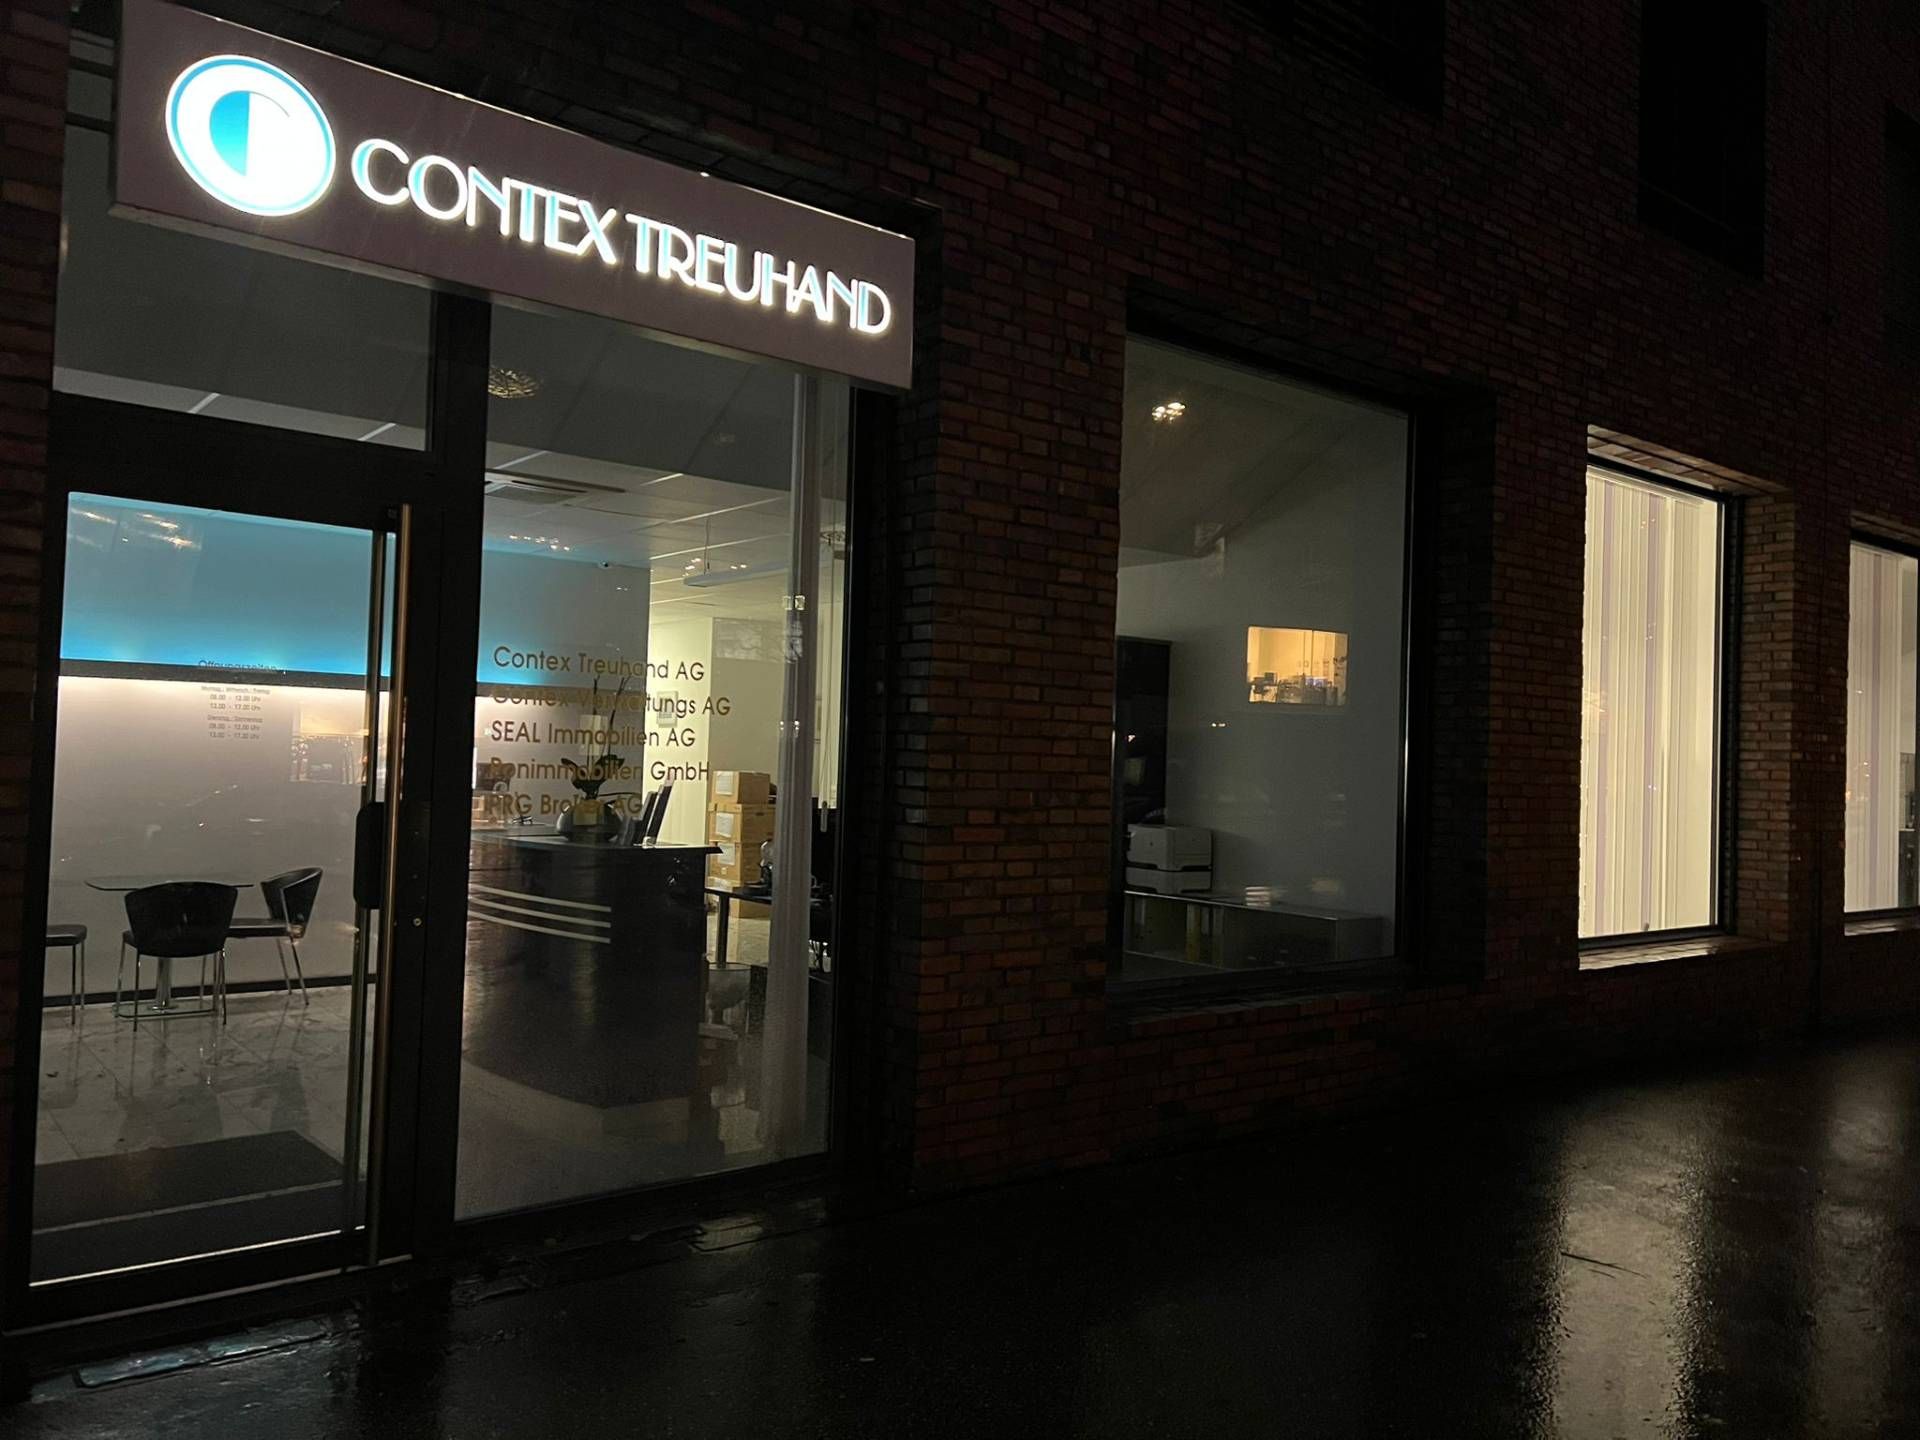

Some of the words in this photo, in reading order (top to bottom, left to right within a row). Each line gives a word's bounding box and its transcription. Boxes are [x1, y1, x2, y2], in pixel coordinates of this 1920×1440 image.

[351, 137, 617, 265] CONTEX
[626, 211, 893, 335] TREUHAND
[493, 645, 570, 672] Contex
[578, 651, 670, 679] Treuhand
[675, 661, 705, 681] AG
[577, 688, 697, 719] Verwatungs
[702, 696, 732, 716] AG
[490, 719, 541, 744] SEAL
[548, 723, 660, 746] Immobilien
[666, 728, 697, 747] AG
[650, 760, 710, 781] GmbH
